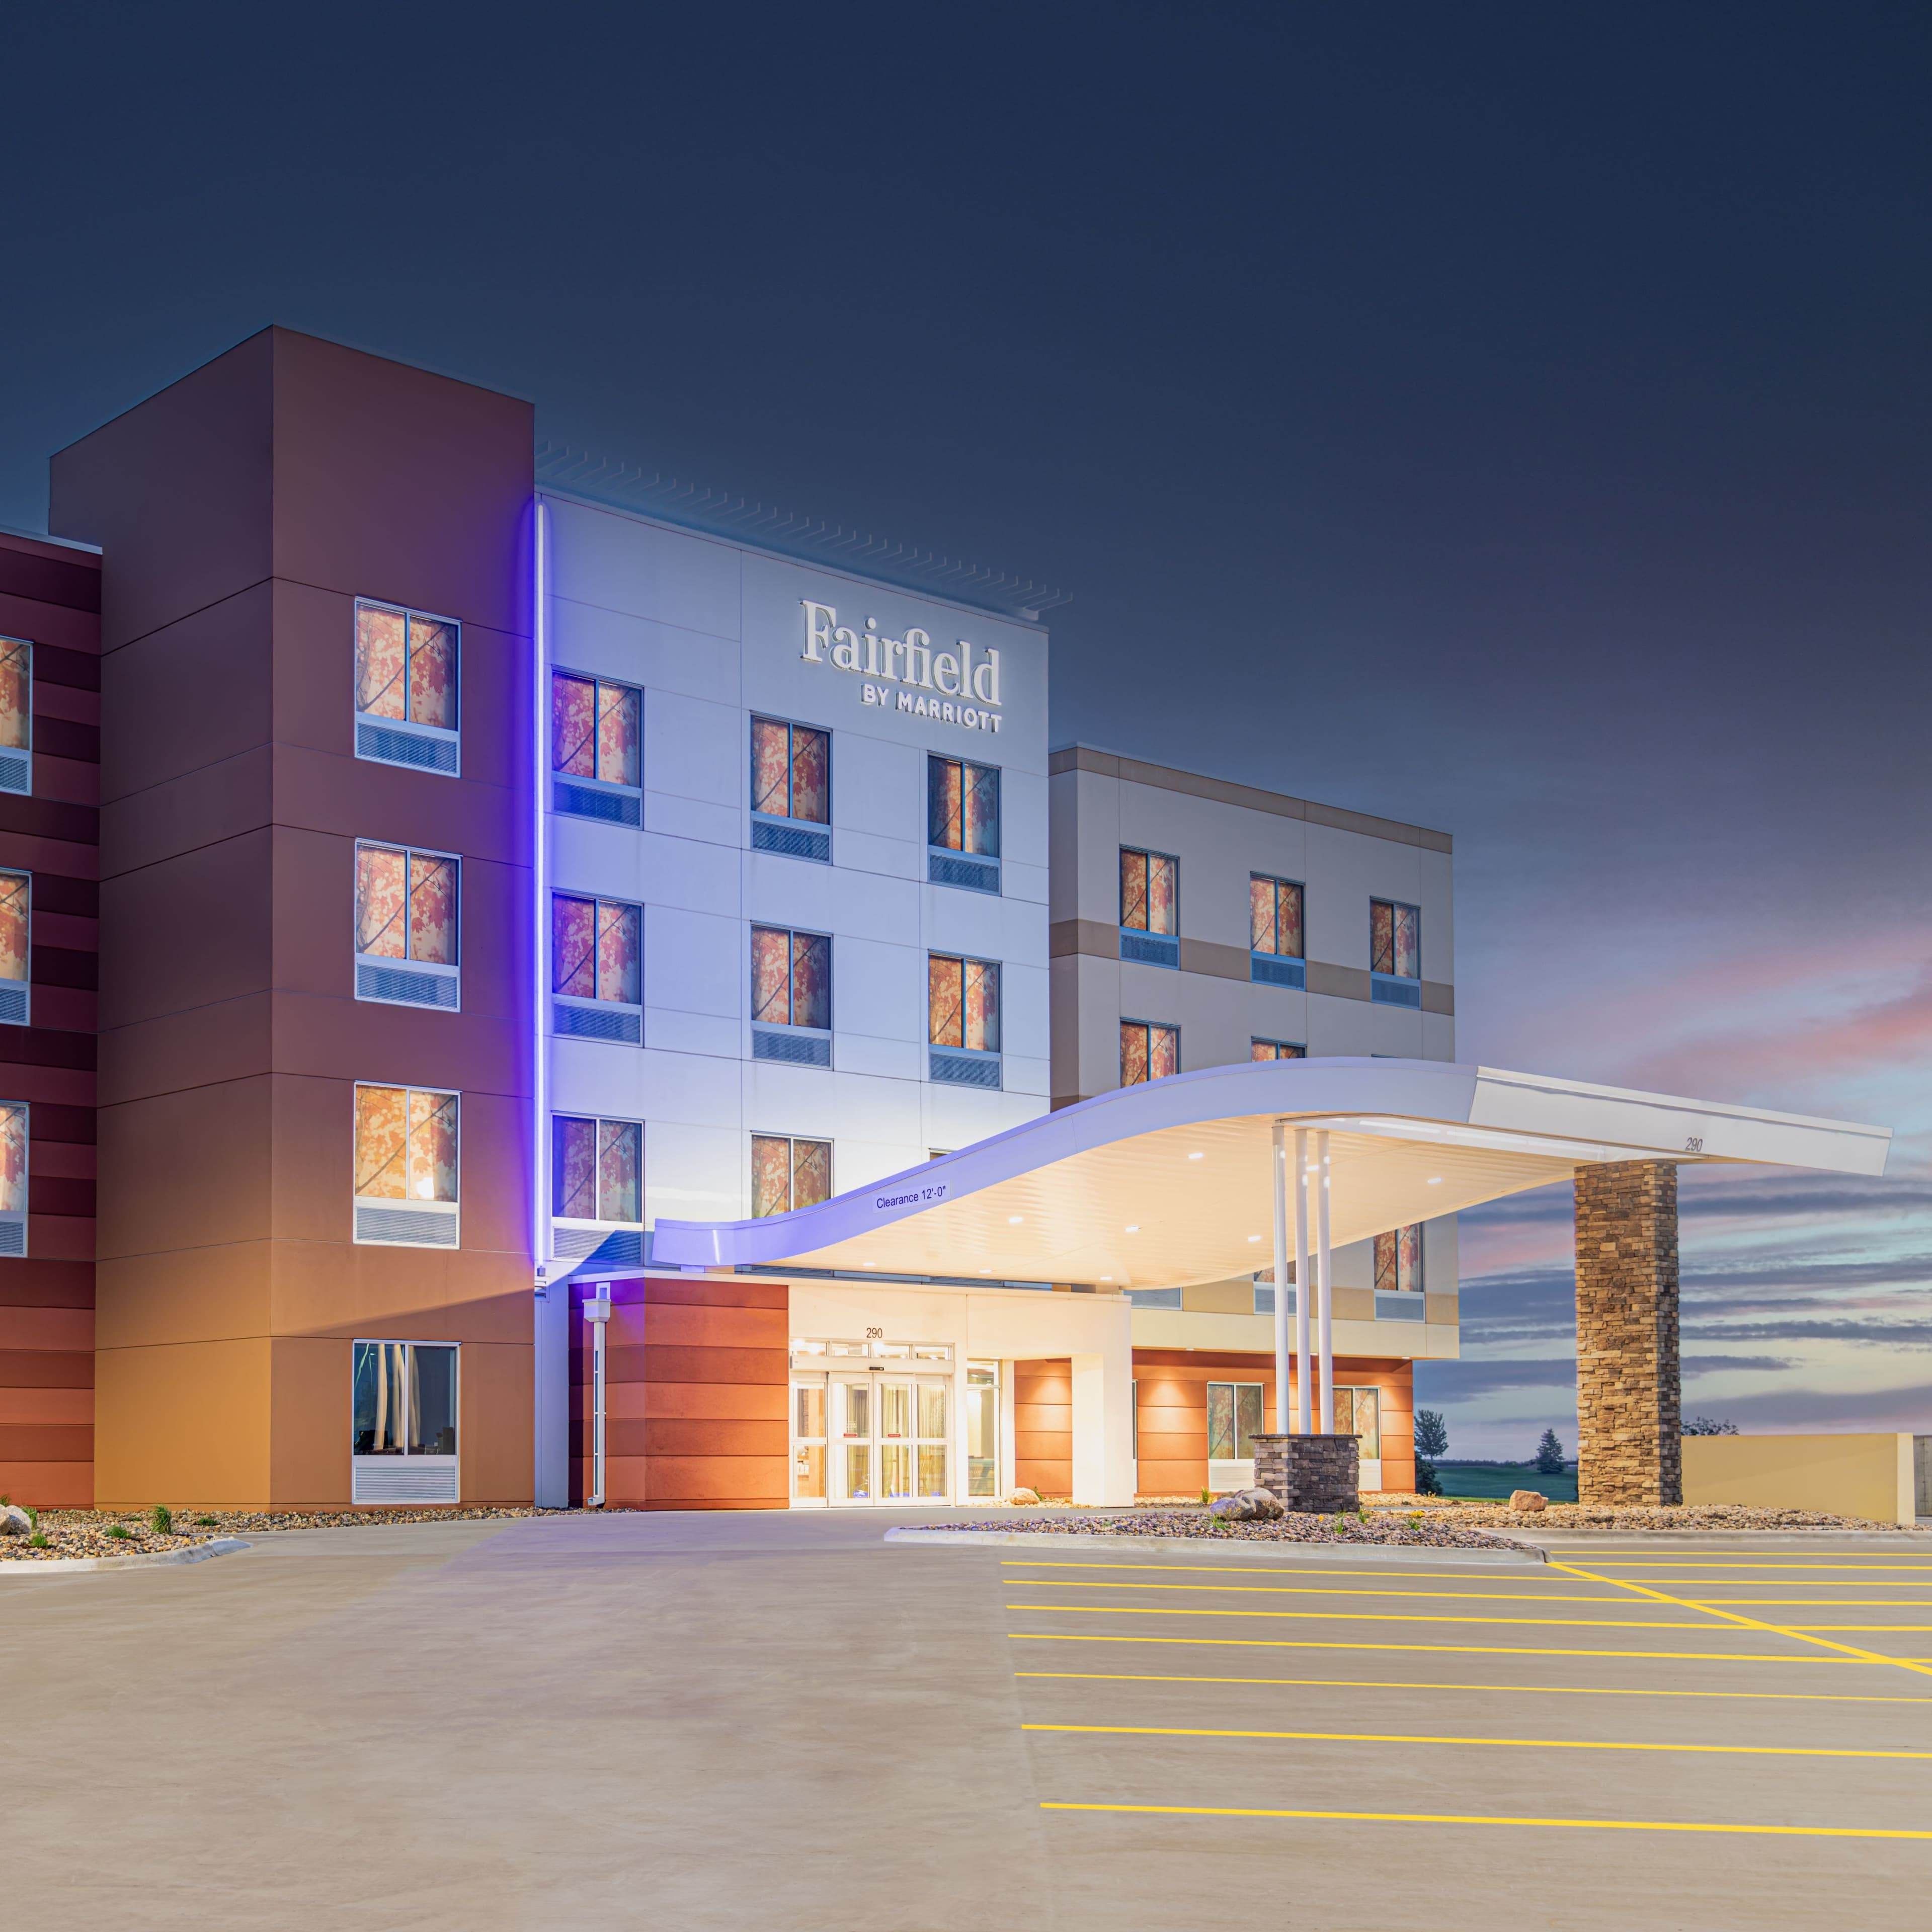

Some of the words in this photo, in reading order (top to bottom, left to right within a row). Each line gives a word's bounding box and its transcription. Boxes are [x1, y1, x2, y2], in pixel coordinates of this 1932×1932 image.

[800, 600, 1002, 705] Fairfield
[861, 684, 889, 706] BY
[895, 691, 1002, 733] MARRIOTT
[1685, 1137, 1703, 1152] 290
[876, 1193, 919, 1209] Clearance
[866, 1327, 882, 1338] 290
